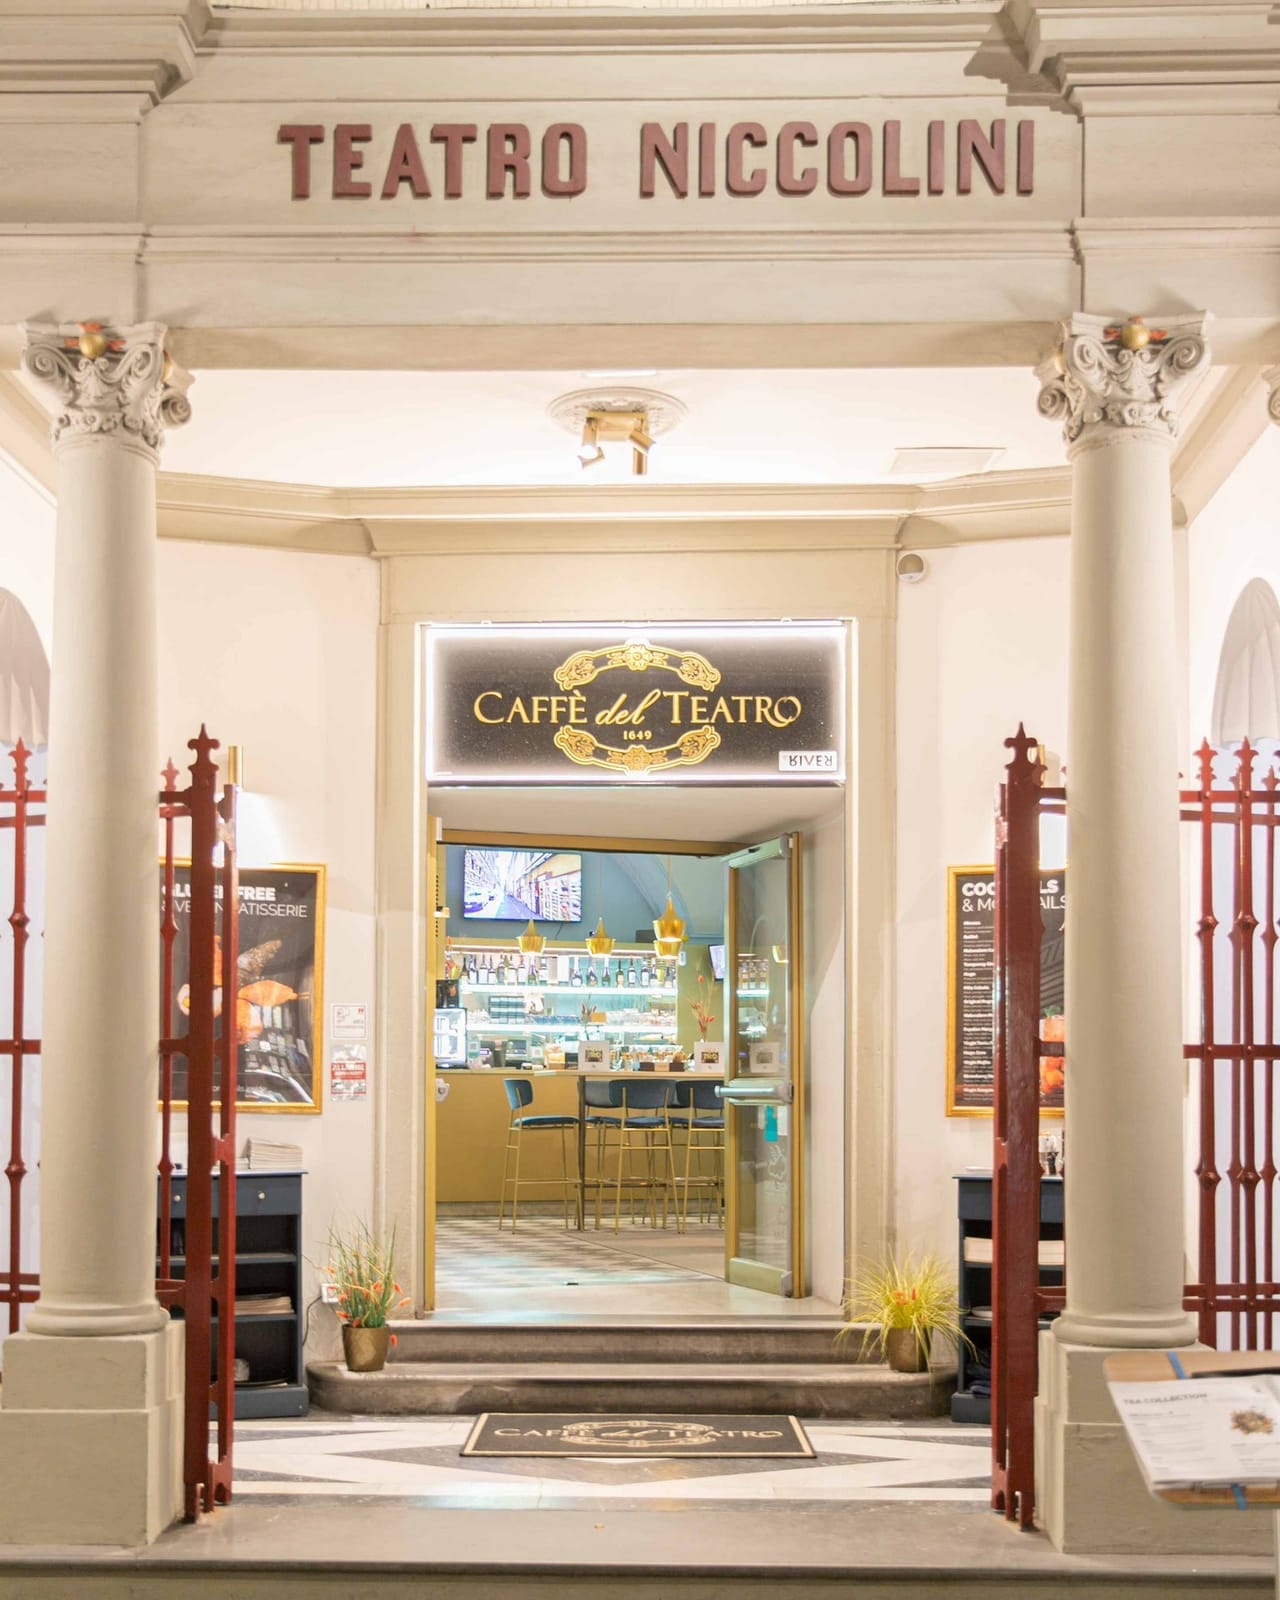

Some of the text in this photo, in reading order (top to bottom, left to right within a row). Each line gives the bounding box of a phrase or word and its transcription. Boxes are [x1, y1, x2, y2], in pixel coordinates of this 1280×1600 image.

[278, 119, 1035, 200] TEATRO NICCOLINI
[473, 688, 802, 728] CAFFÈ del TEATRO
[623, 730, 652, 740] 1649
[238, 902, 308, 918] ATISSERIE
[962, 898, 974, 912] &
